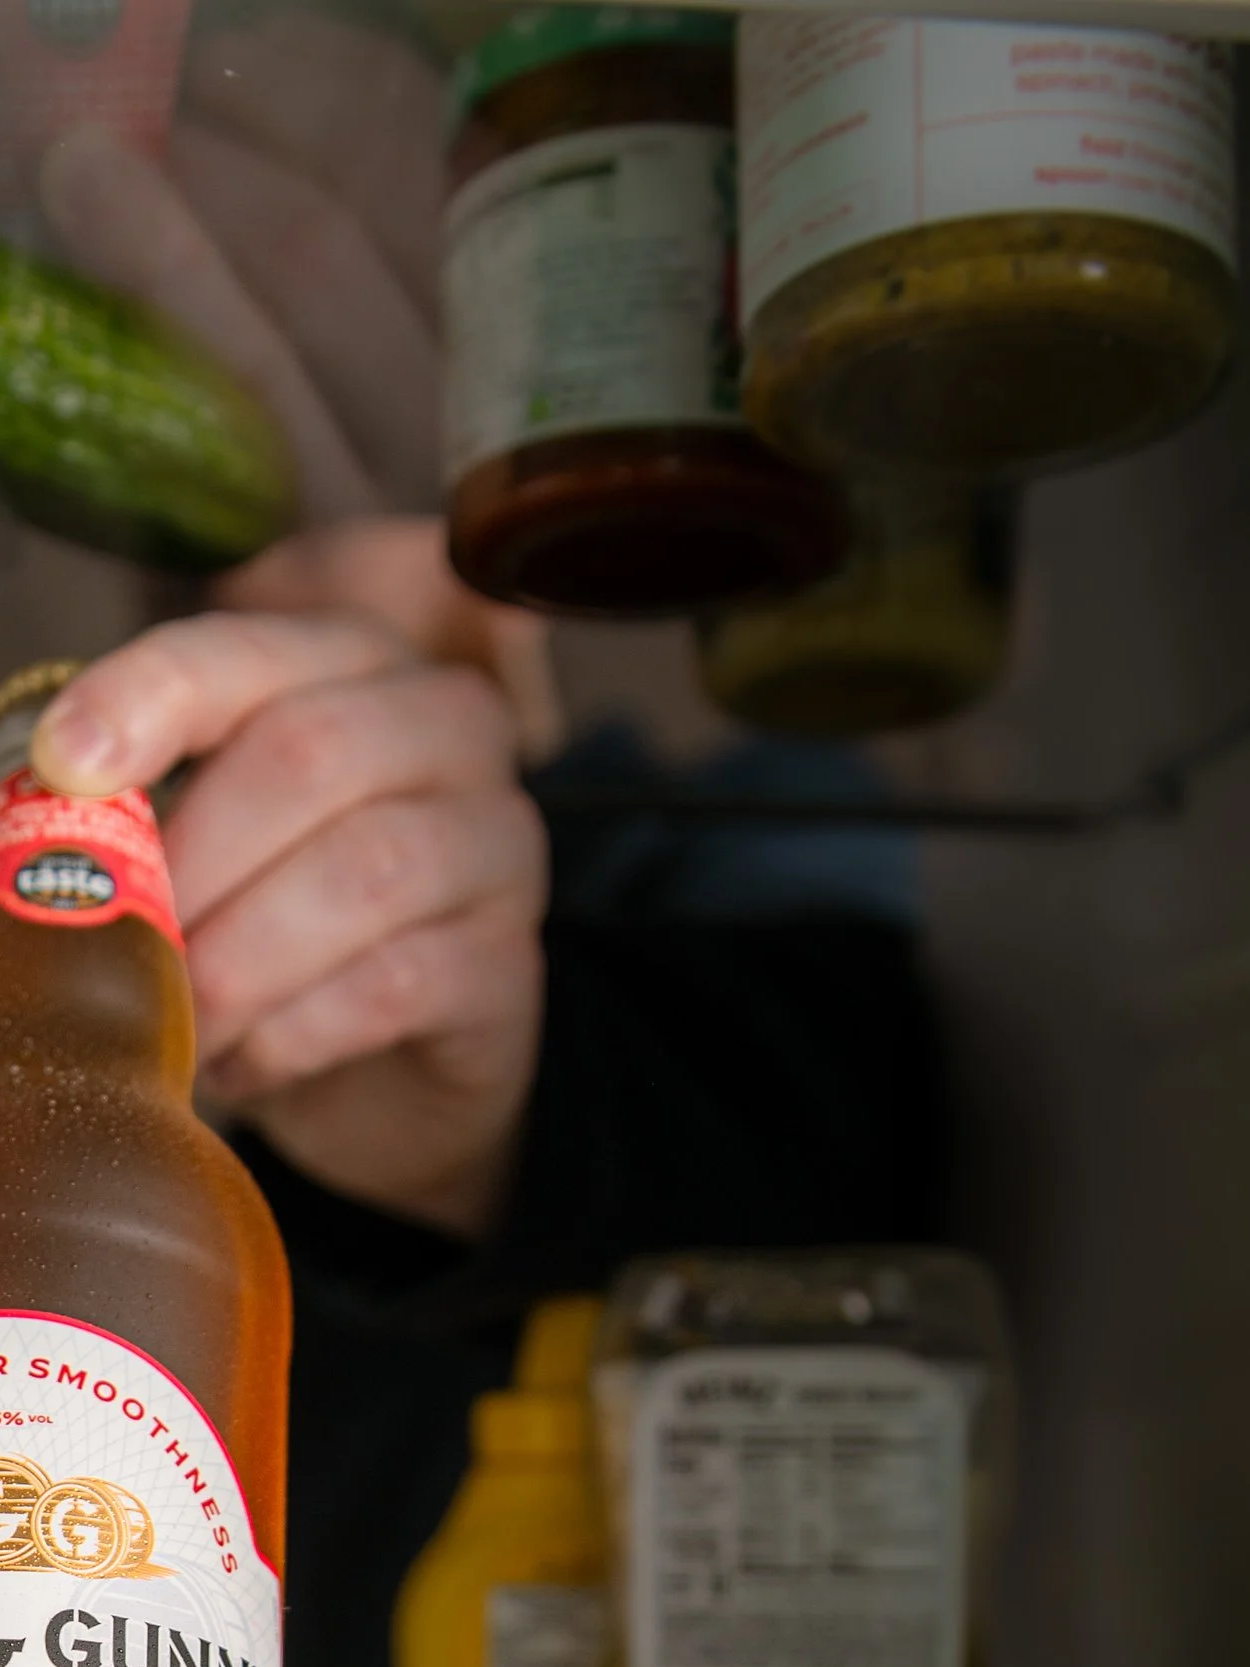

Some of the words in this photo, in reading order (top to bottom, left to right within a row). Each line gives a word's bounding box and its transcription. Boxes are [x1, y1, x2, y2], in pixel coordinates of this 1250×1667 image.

[28, 1414, 54, 1425] VOL
[28, 1357, 239, 1575] SMOOTHNESS
[50, 1497, 100, 1558] G
